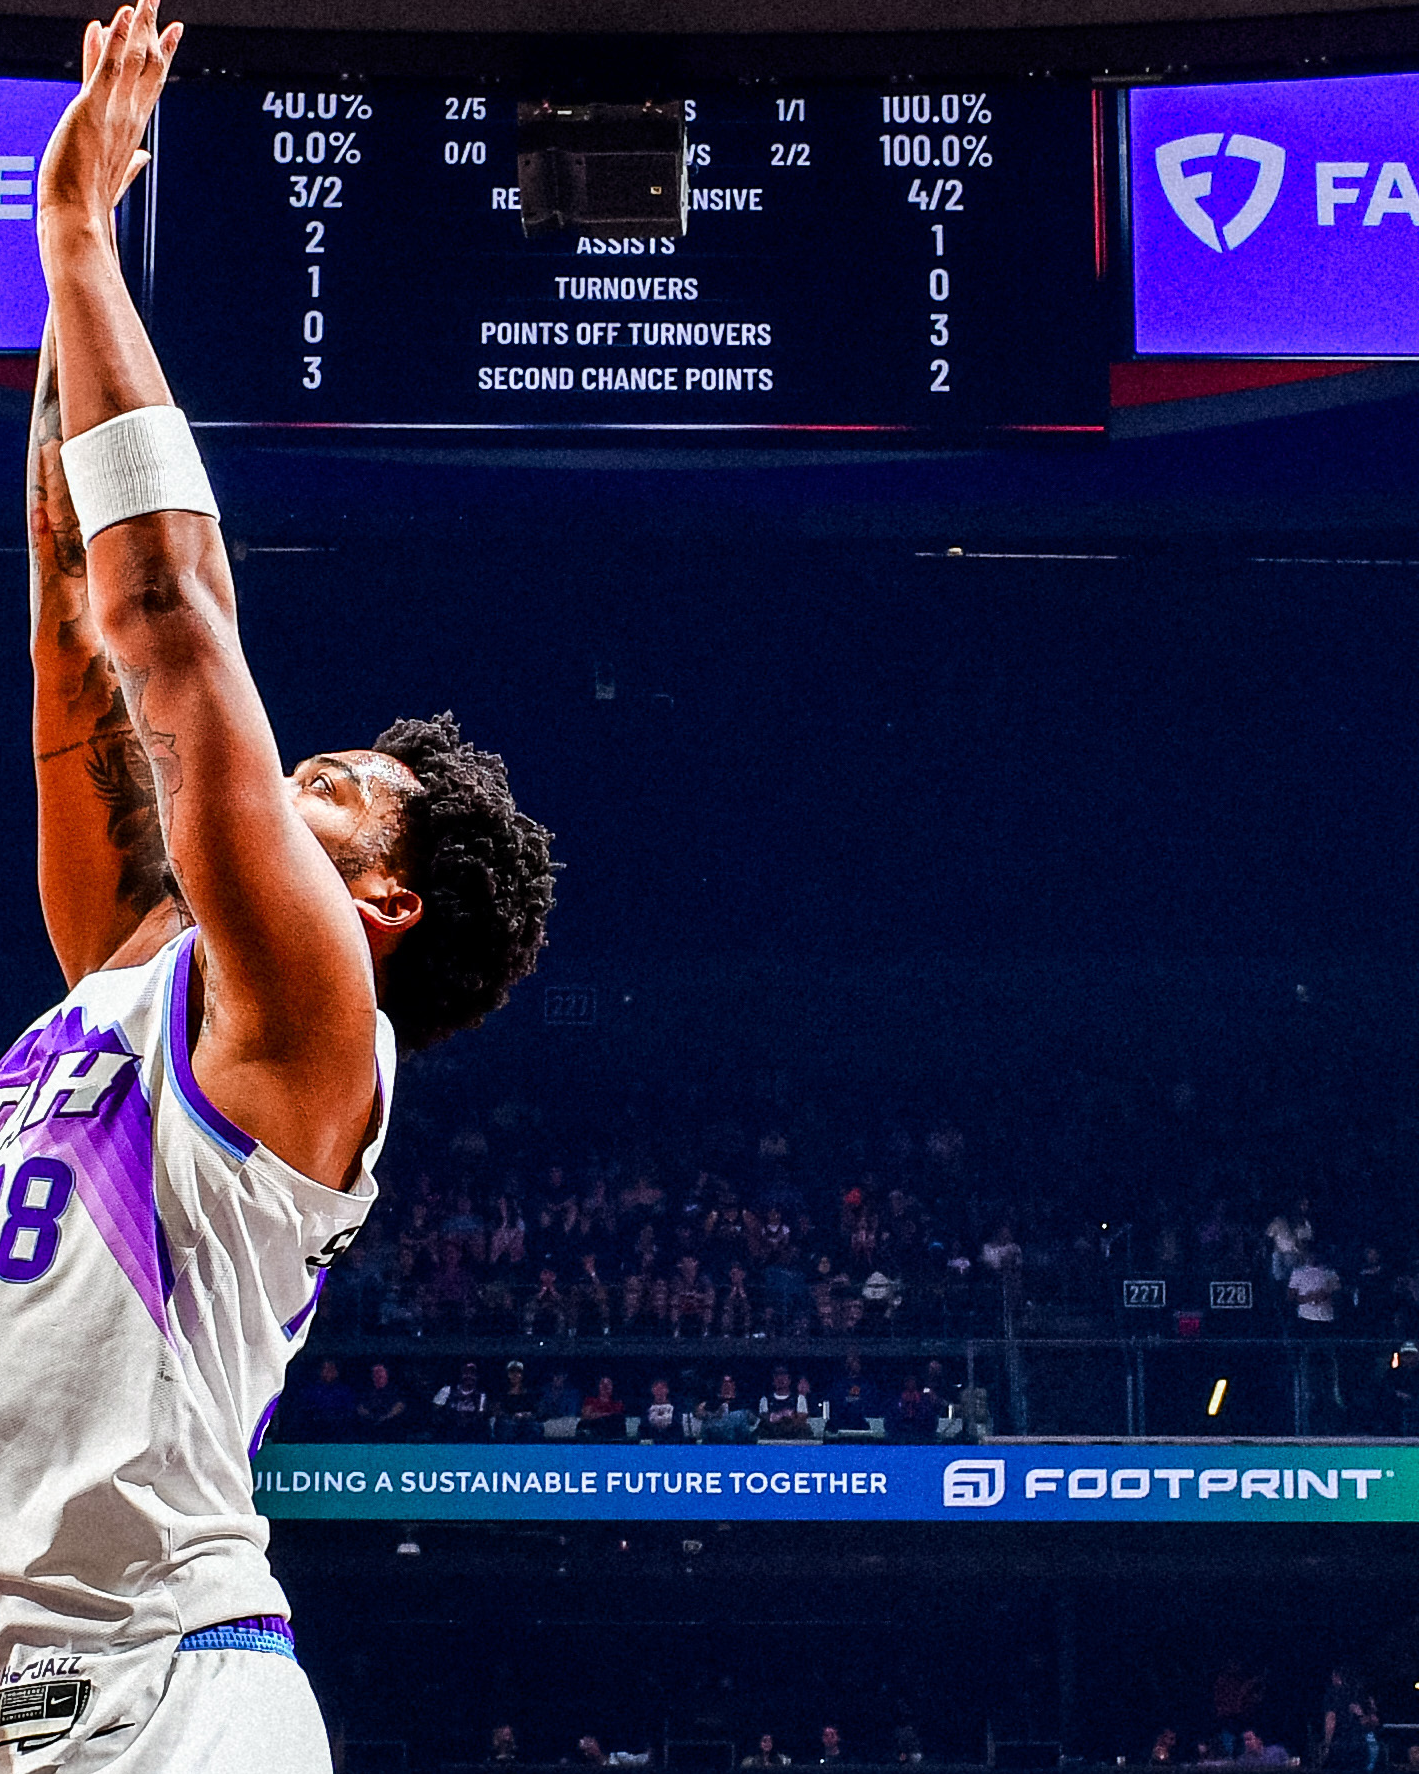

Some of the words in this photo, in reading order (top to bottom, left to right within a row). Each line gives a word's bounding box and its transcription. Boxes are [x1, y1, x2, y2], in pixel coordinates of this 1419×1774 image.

[445, 98, 486, 121] 2/5
[776, 98, 805, 122] 1/1
[880, 93, 992, 124] 100.0%
[273, 131, 362, 165] 0.0%
[444, 142, 486, 165] 0/0
[770, 143, 811, 167] 2/2
[879, 134, 992, 167] 100.0%
[289, 175, 343, 209] 3/2
[907, 179, 964, 212] 4/2
[305, 221, 325, 254] 2
[930, 224, 944, 256] 1
[307, 265, 320, 298] 1
[555, 277, 699, 301] TURNOVERS
[929, 268, 949, 301] 0
[303, 311, 324, 344] 0
[481, 323, 569, 346] POINTS
[576, 323, 621, 346] OFF
[628, 323, 772, 346] TURNOVERS
[930, 313, 949, 346] 3
[302, 356, 322, 390] 3
[478, 368, 575, 391] SECOND
[581, 368, 678, 391] CHANCE
[685, 368, 773, 391] POINTS
[930, 359, 950, 392] 2
[1130, 1285, 1159, 1304] 227
[374, 1471, 394, 1493] A
[401, 1471, 598, 1494] SUSTAINABLE
[606, 1472, 722, 1494] FUTURE
[728, 1472, 887, 1494] TOGETHER
[1025, 1468, 1383, 1500] FOOTPRINT
[31, 1656, 82, 1679] JAZZ
